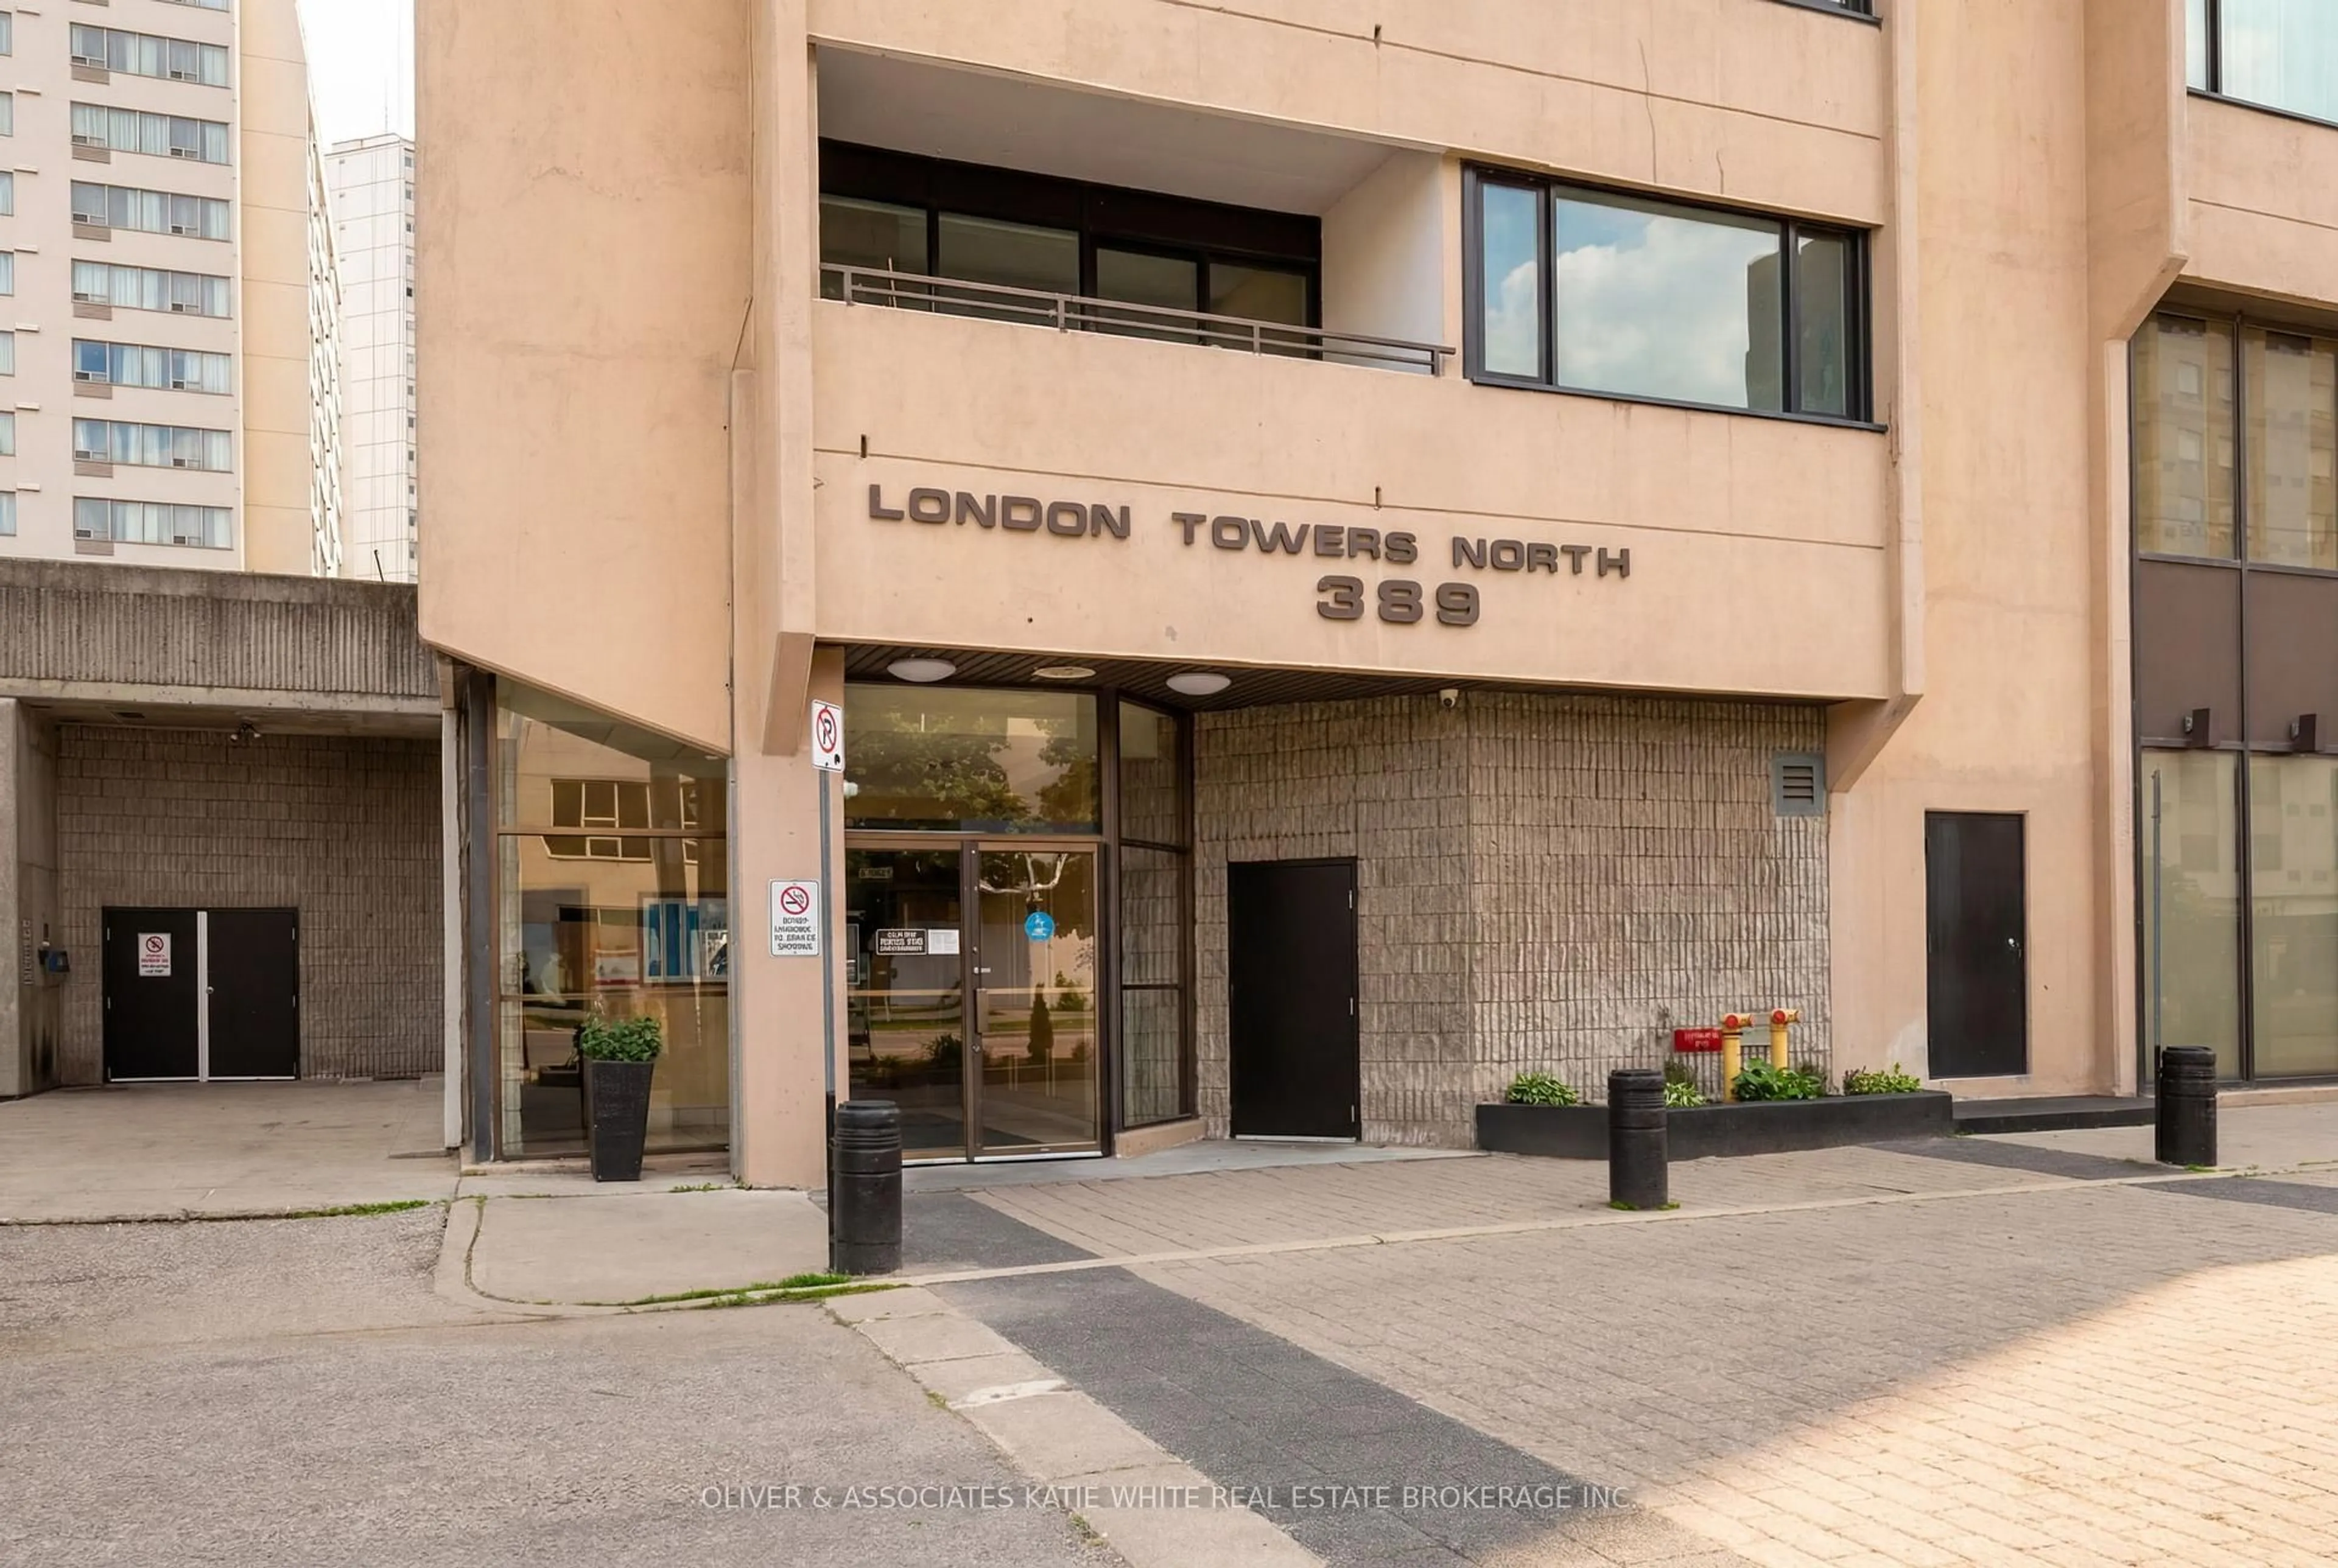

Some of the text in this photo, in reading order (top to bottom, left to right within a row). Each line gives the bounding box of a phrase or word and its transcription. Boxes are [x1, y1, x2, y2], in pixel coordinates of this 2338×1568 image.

[869, 485, 1631, 578] LONDON TOWERS NORTH
[1317, 575, 1480, 626] 389
